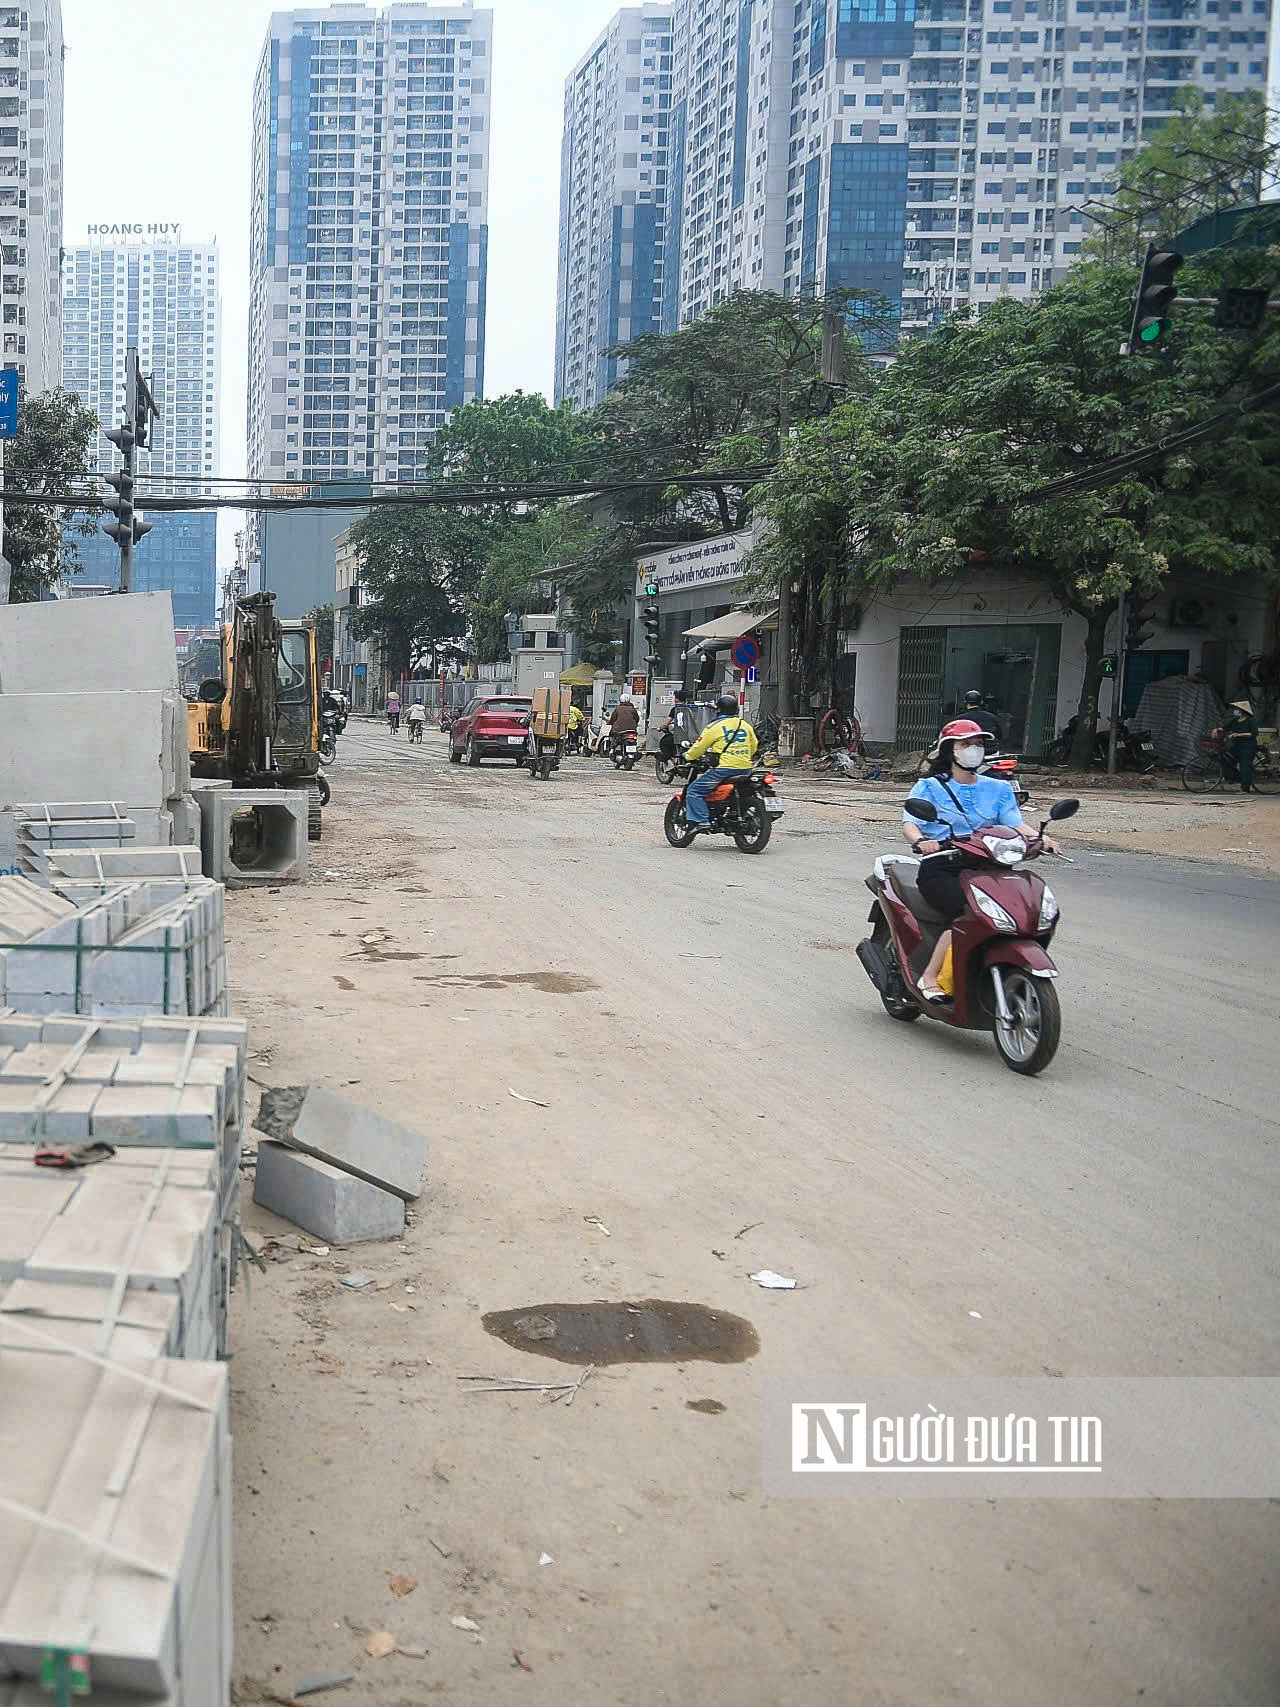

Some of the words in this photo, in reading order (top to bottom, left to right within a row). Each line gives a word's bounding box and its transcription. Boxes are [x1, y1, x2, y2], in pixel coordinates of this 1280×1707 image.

[87, 224, 143, 234] HOANG
[148, 223, 179, 234] HUY
[721, 726, 748, 743] be
